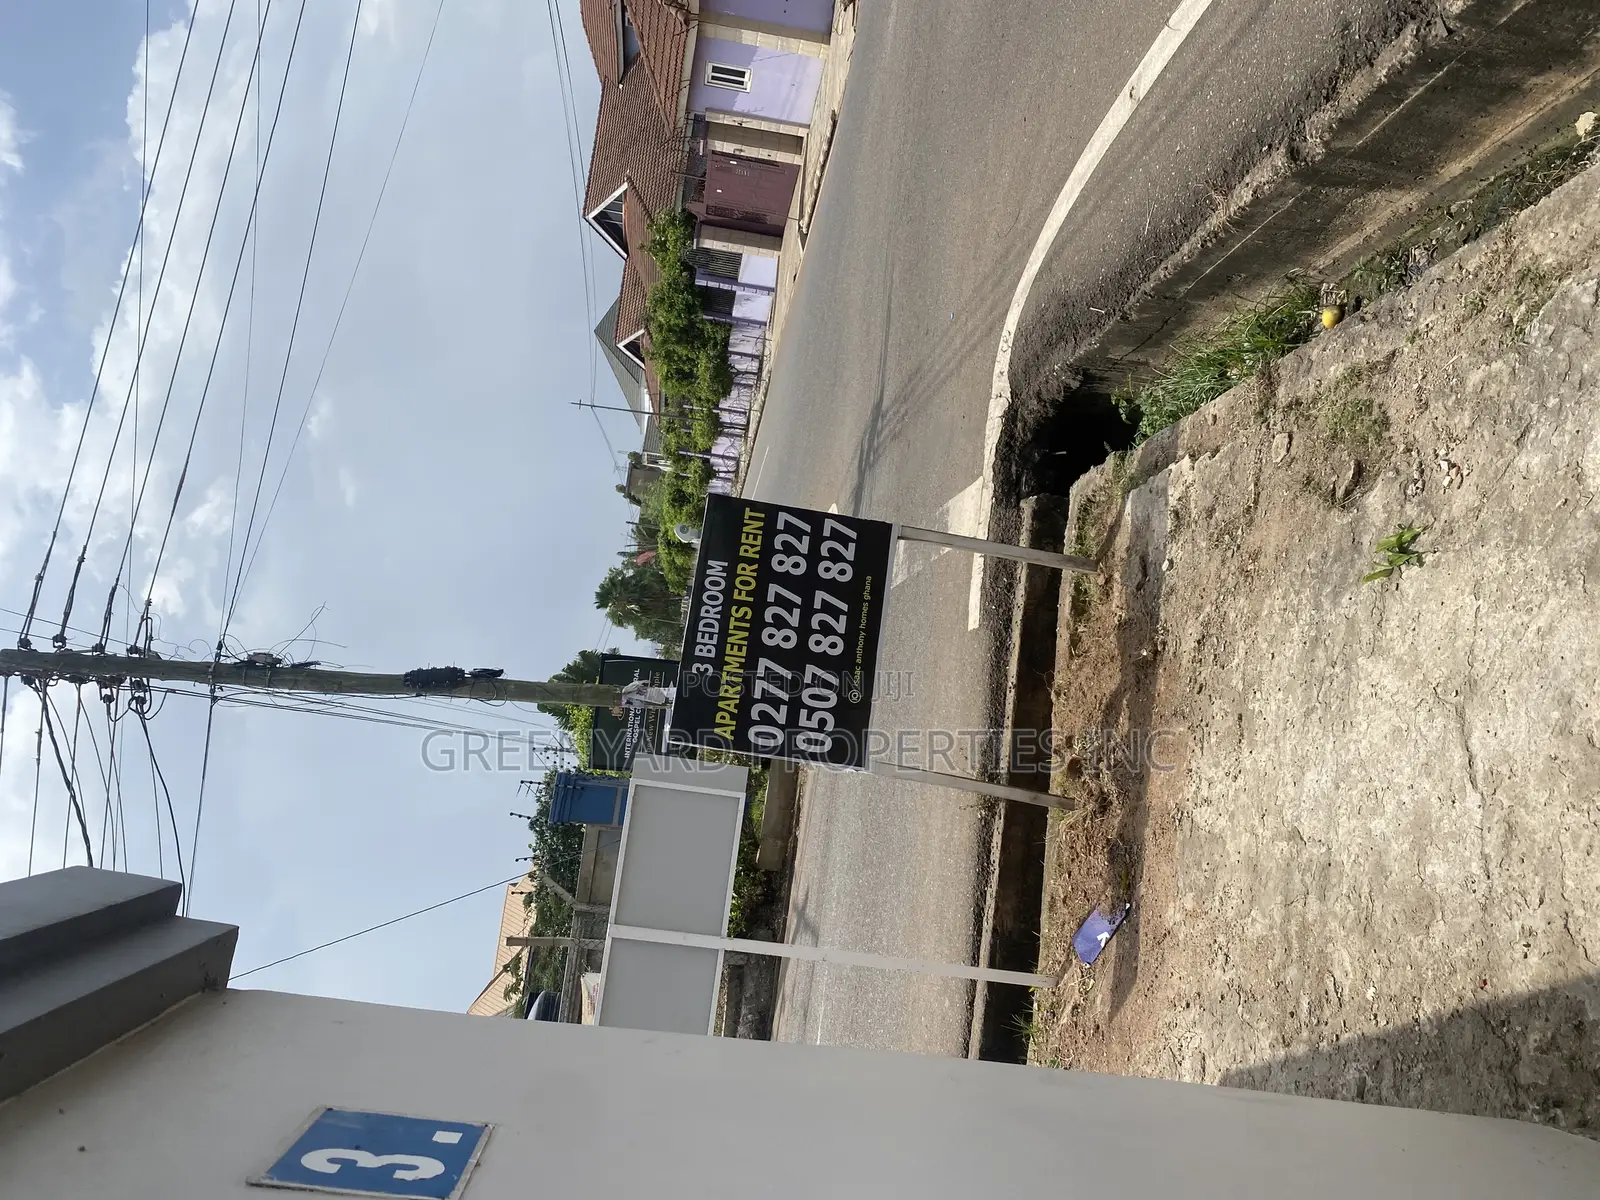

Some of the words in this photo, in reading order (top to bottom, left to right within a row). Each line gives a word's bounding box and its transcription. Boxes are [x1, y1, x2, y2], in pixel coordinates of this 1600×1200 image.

[739, 507, 766, 559] RENT
[771, 511, 812, 576] 827
[817, 518, 858, 583] 827
[694, 560, 728, 658] BEDROOM
[733, 562, 759, 602] FOR
[863, 575, 872, 601] ghana
[761, 583, 802, 650] 827
[808, 590, 849, 656] 827
[859, 602, 869, 629] homes
[691, 662, 714, 677] 3
[714, 605, 753, 740] APARTMENTS
[855, 631, 867, 664] anthony
[632, 714, 642, 743] GOSPEL
[747, 657, 793, 747] 0277
[796, 664, 840, 753] 0507
[624, 707, 636, 759] INTERNATIONA
